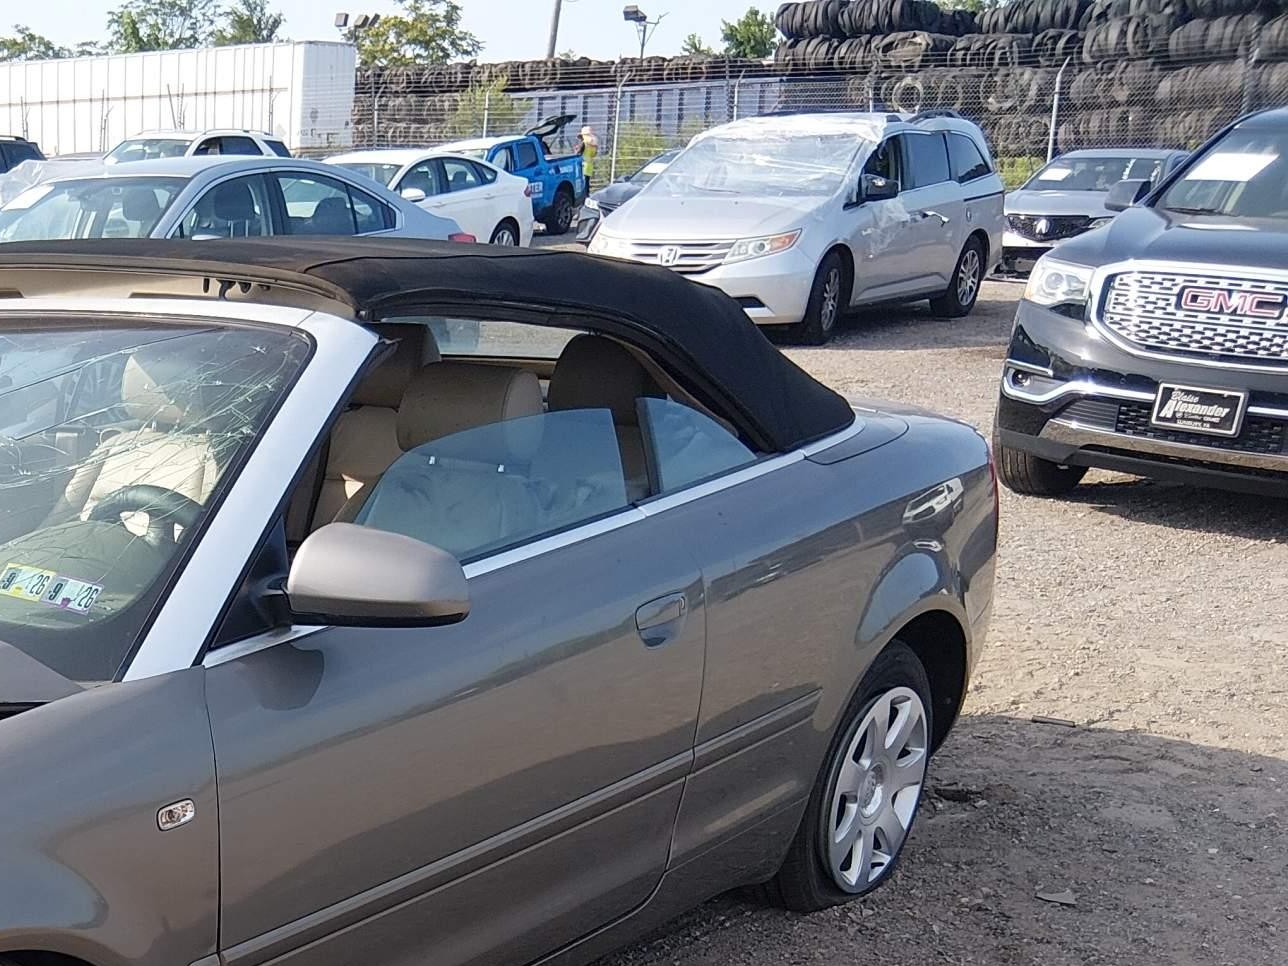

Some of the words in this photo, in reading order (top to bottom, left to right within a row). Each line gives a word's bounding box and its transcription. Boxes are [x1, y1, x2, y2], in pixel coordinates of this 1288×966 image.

[1181, 287, 1284, 318] GMC
[1158, 399, 1231, 419] Alexander
[30, 574, 51, 596] 26
[77, 586, 99, 609] 26
